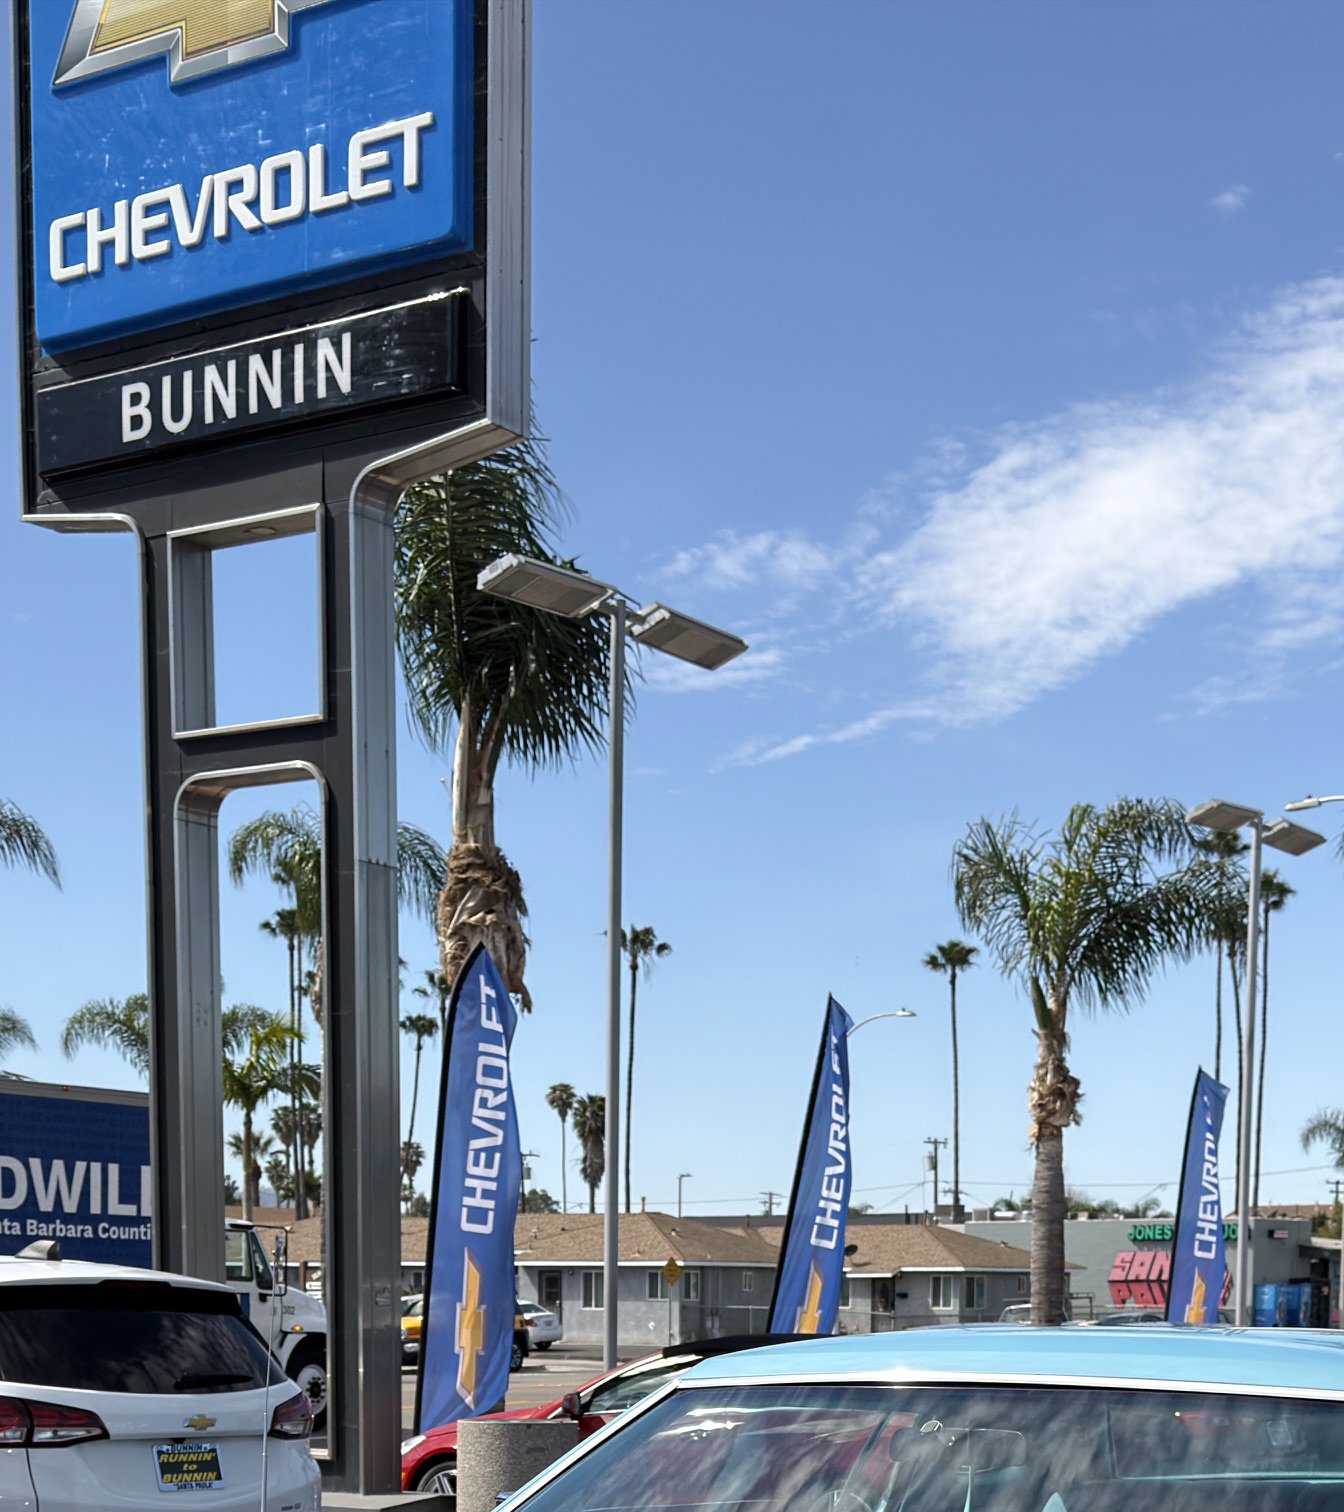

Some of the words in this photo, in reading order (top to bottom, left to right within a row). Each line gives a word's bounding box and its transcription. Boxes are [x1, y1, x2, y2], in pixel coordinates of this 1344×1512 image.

[49, 111, 434, 282] CHEVROLET
[121, 332, 352, 443] BUNNIN
[26, 1219, 94, 1239] Barbara
[97, 1222, 152, 1241] Counti
[1128, 1224, 1174, 1241] JONES
[159, 1452, 216, 1463] RUNNIN'
[183, 1463, 198, 1471] to
[162, 1472, 218, 1484] BUNNIN
